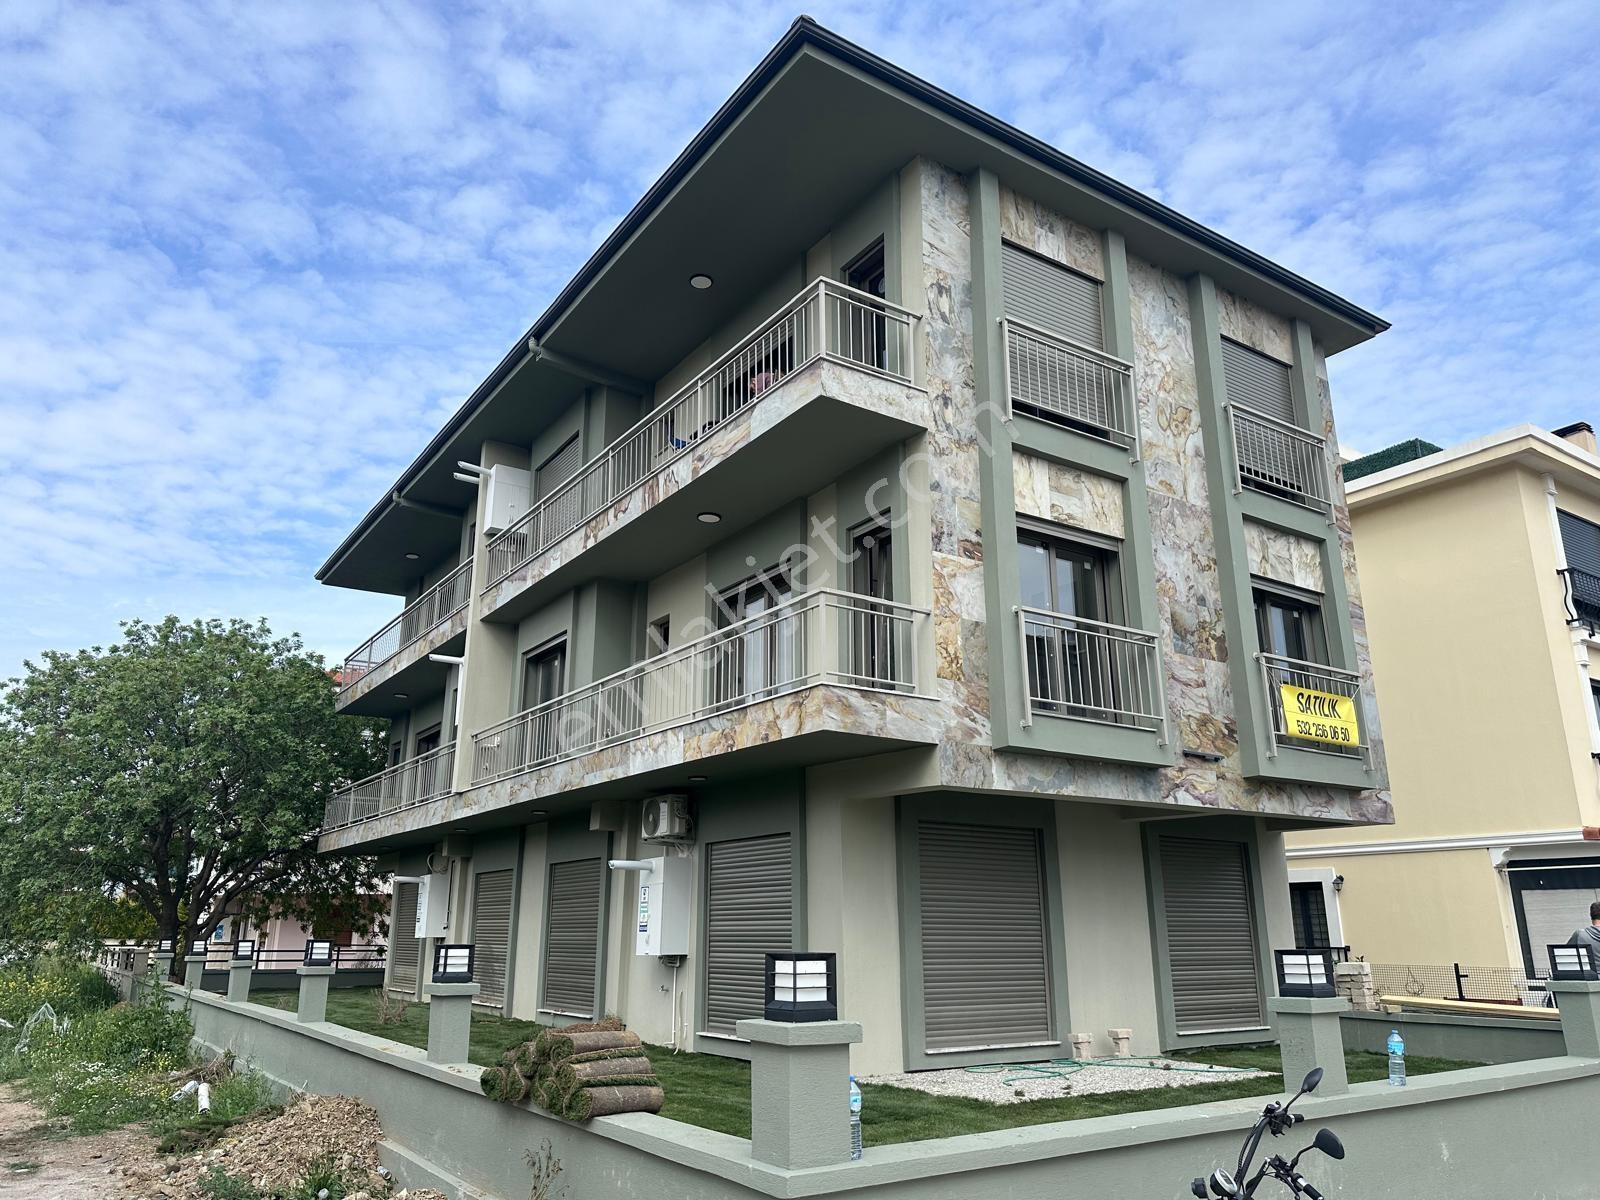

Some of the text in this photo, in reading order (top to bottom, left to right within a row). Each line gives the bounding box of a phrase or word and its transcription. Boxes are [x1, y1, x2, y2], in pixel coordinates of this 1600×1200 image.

[1297, 692, 1341, 719] SATILIK
[1297, 720, 1350, 742] 532 256 06 50
